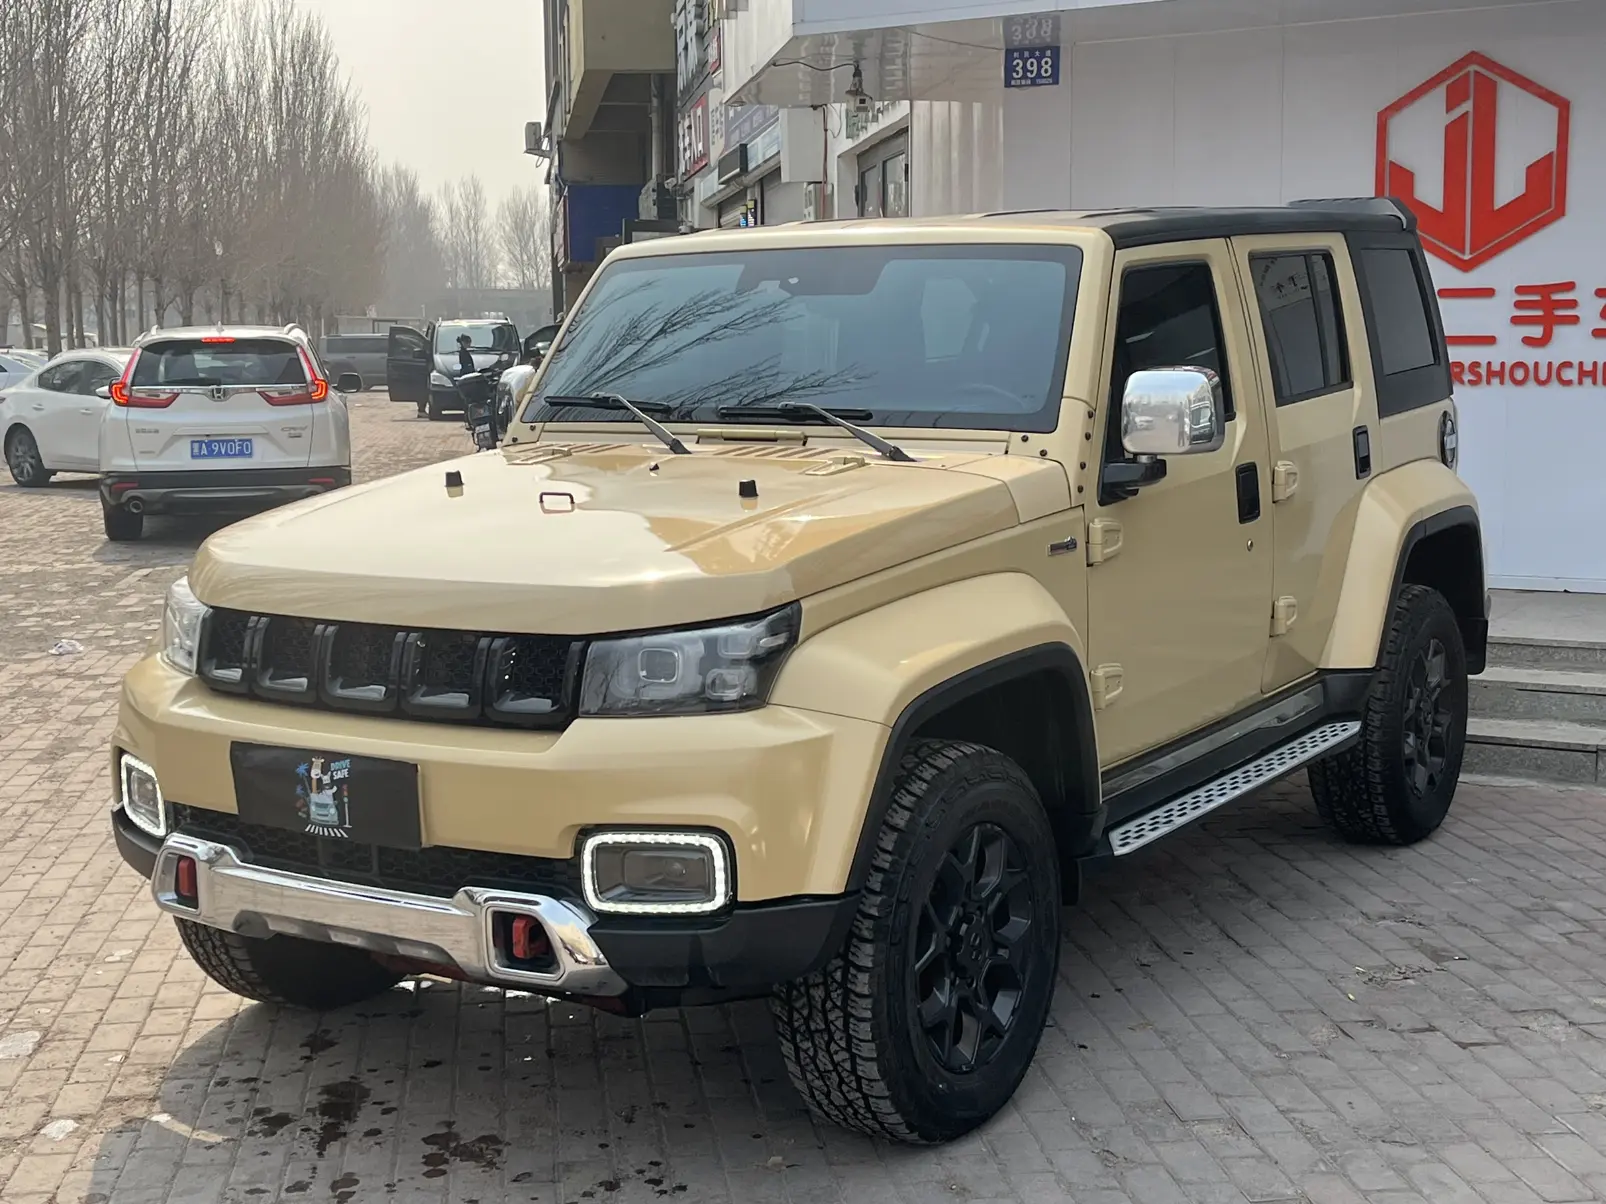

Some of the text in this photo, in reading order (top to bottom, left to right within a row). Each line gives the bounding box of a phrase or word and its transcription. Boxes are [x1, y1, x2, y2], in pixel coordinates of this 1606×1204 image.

[1012, 57, 1052, 78] 398
[1437, 281, 1606, 347] 二手
[1450, 361, 1606, 386] RSHOUCH
[330, 759, 350, 771] DRIVE
[333, 769, 349, 780] SAFE
